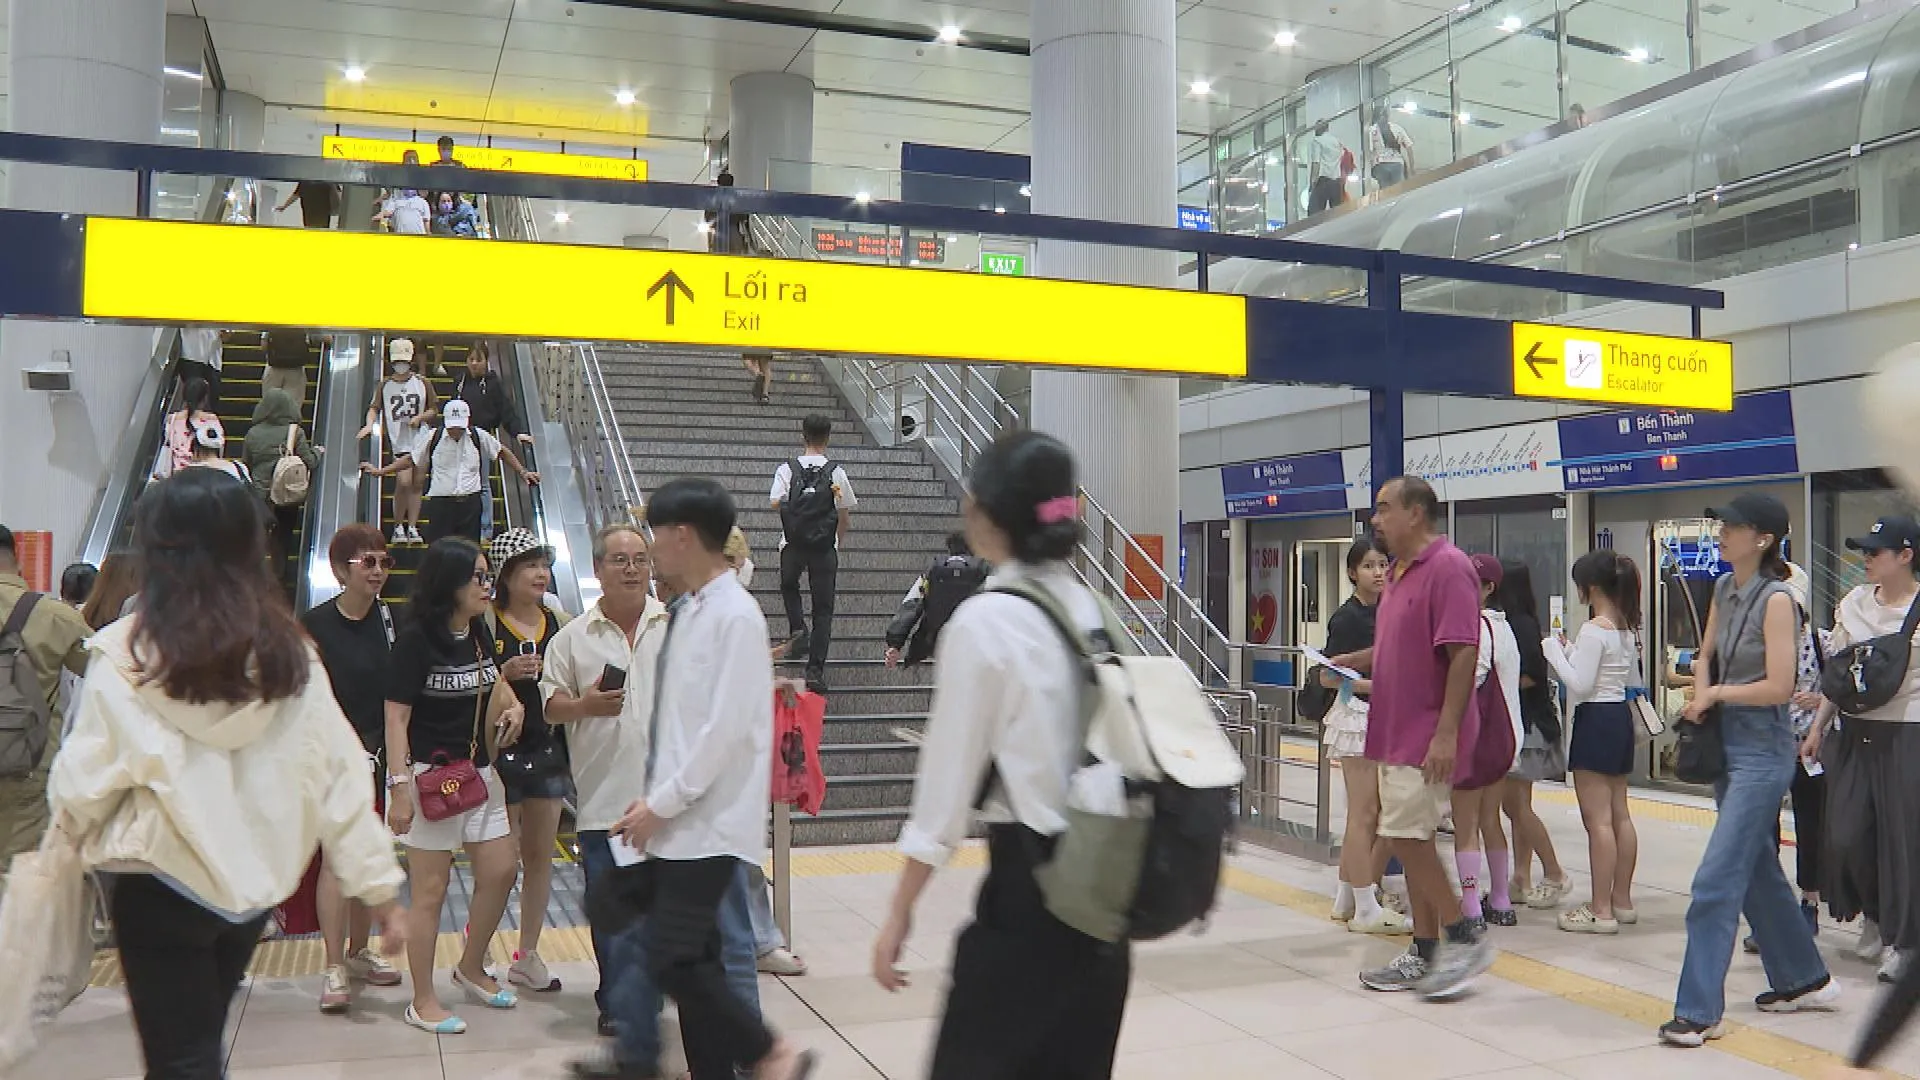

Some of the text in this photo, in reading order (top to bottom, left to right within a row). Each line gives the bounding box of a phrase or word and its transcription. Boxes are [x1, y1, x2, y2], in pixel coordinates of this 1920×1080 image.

[988, 257, 1017, 270] EXIT
[724, 270, 807, 302] Lối ra
[724, 310, 761, 331] Exit
[1607, 343, 1708, 375] Thang cuốn
[1607, 373, 1664, 393] Escalator
[390, 393, 420, 422] 23
[1636, 410, 1694, 431] Bến Thành
